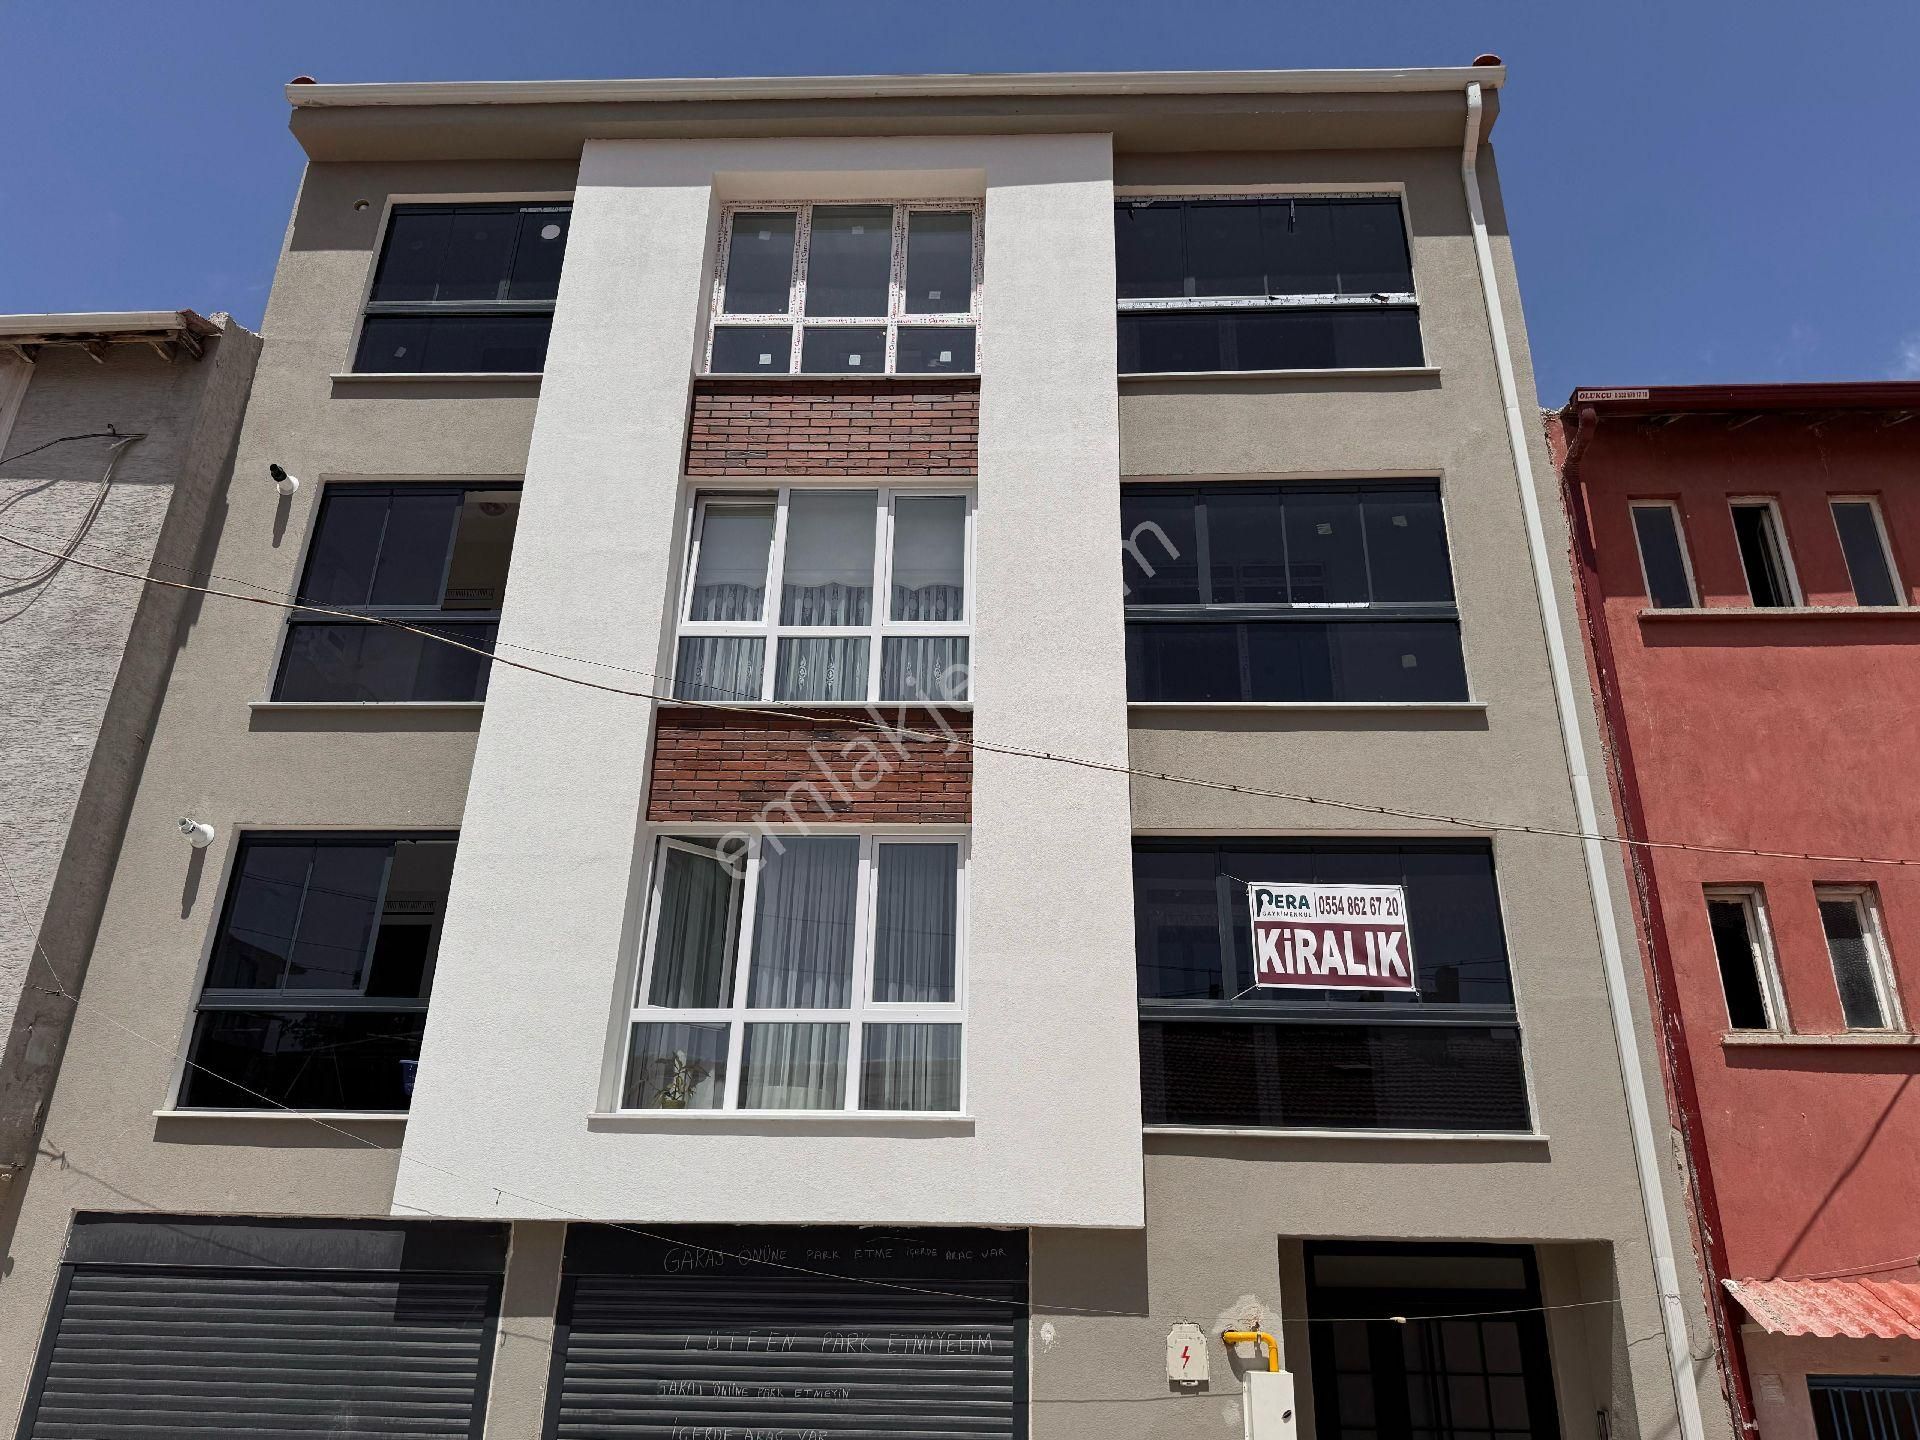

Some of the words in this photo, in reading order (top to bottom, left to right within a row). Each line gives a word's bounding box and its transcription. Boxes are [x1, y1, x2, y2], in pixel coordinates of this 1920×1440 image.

[1255, 889, 1310, 917] PERA
[1318, 895, 1345, 914] 0554
[1347, 896, 1367, 916] 862
[1369, 896, 1382, 916] 67
[1386, 897, 1399, 917] 20
[663, 1247, 724, 1273] GARAJ
[806, 1249, 841, 1260] PARK
[854, 1248, 895, 1259] ETME
[821, 1331, 872, 1353] PARK
